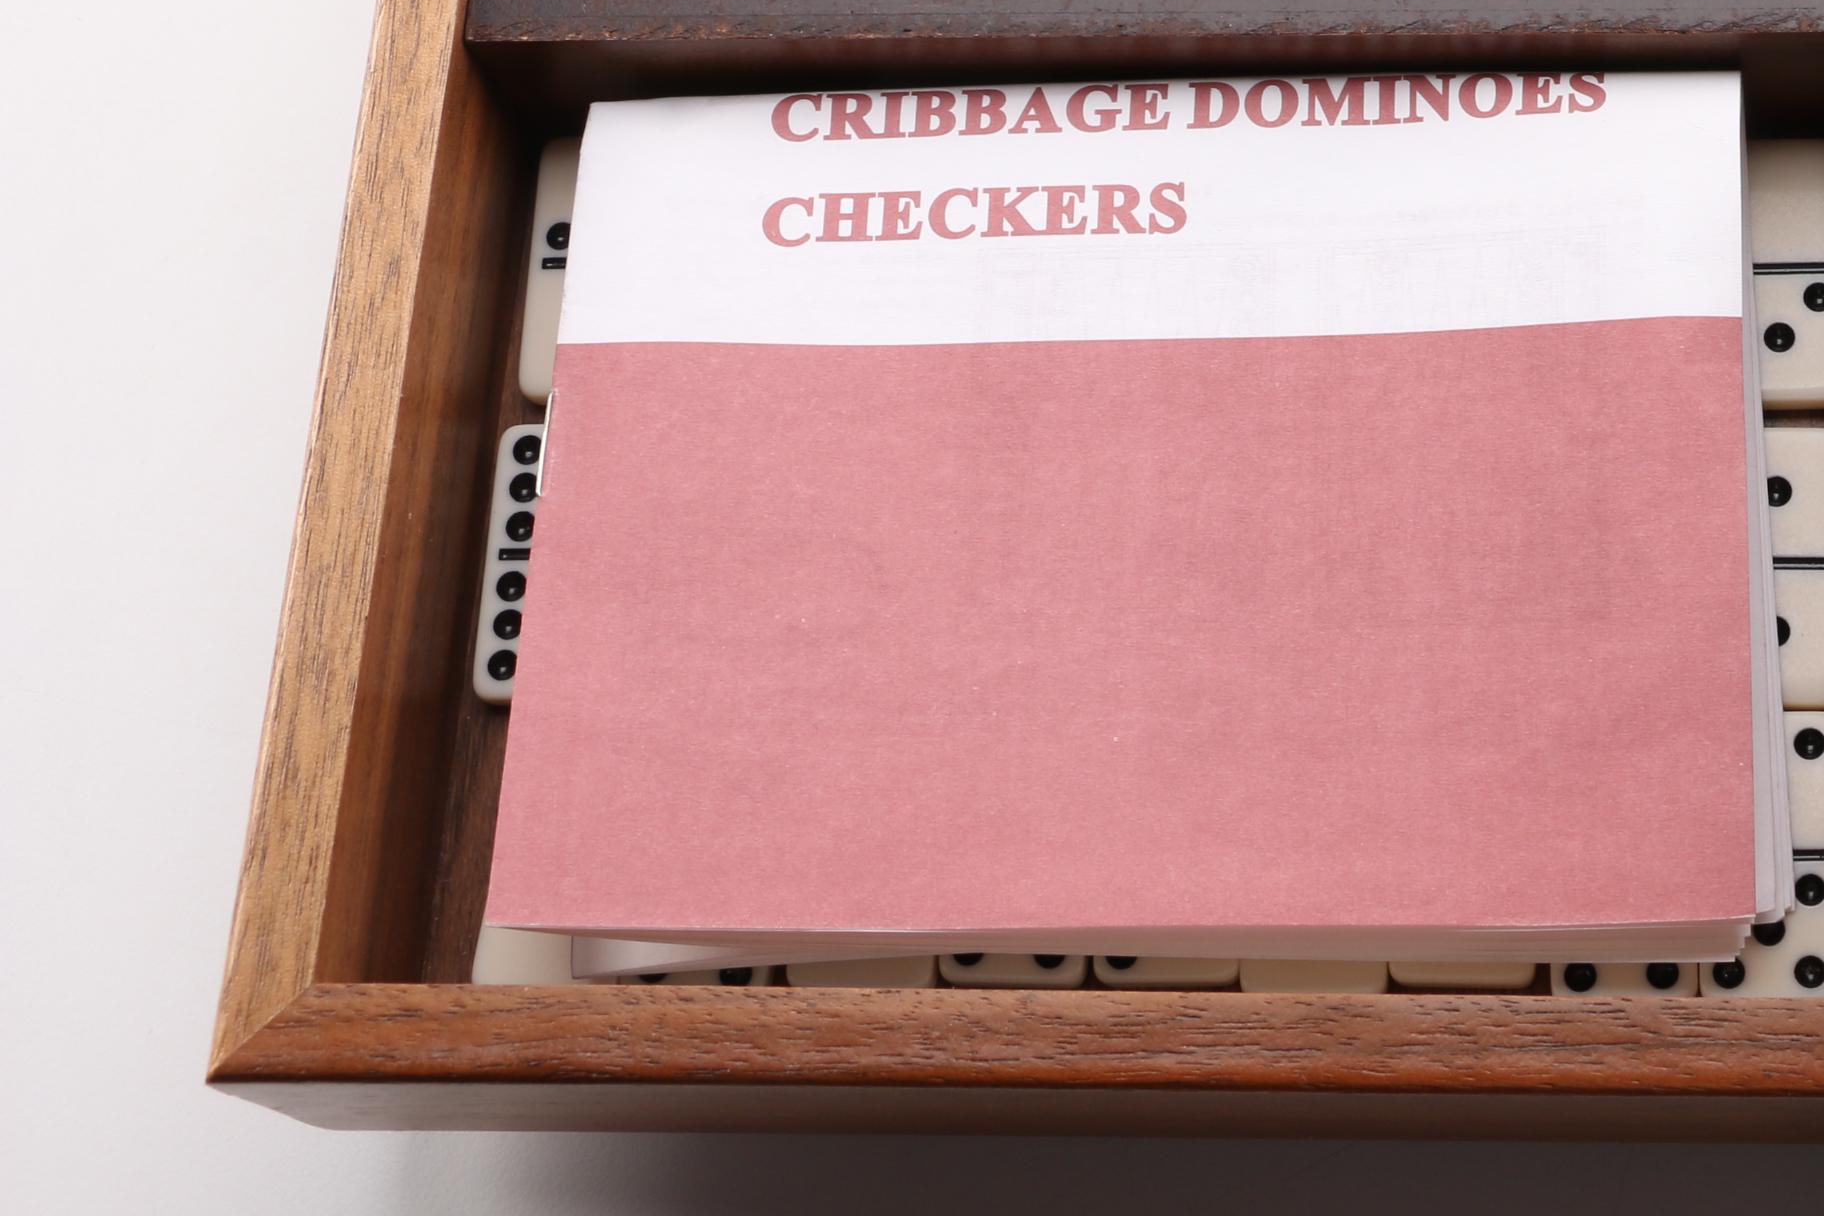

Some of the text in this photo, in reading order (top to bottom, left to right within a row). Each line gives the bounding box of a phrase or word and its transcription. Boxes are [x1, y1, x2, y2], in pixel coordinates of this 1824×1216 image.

[773, 71, 1607, 142] CRIBBAGE DOMINOES
[764, 182, 1187, 247] CHECKERS
